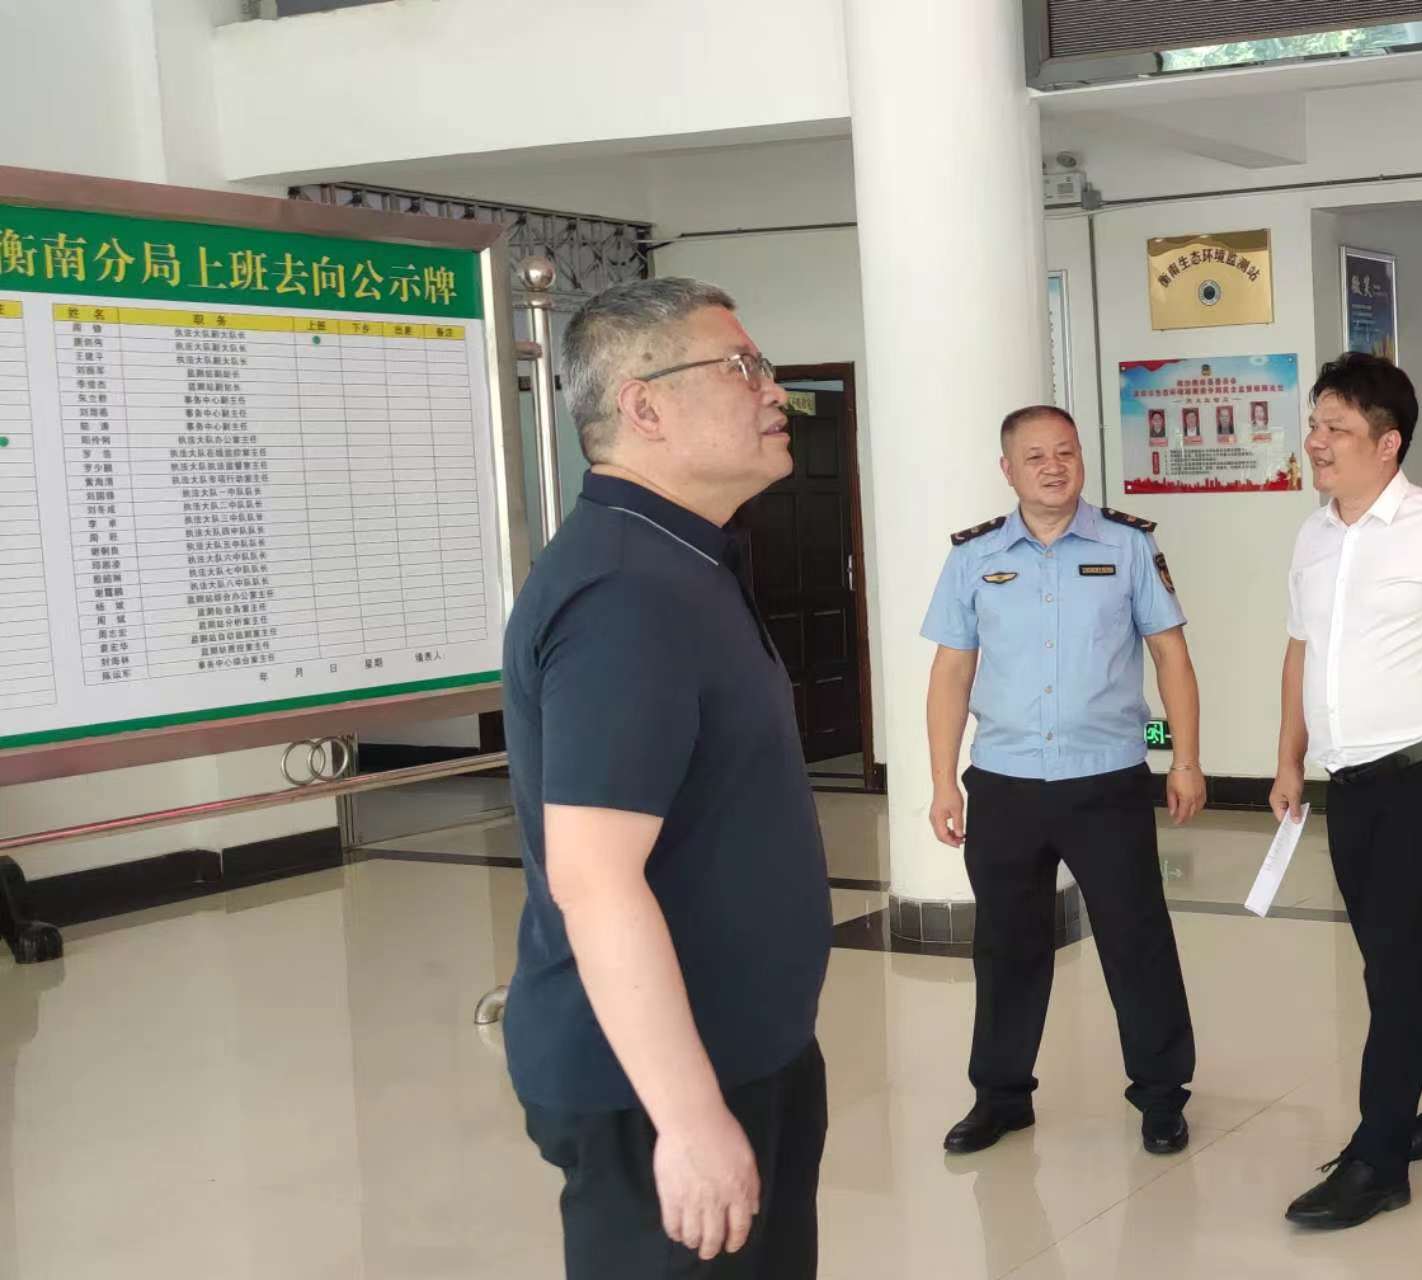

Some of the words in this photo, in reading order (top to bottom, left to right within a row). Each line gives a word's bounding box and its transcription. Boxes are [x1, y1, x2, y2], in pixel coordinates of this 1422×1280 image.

[1158, 248, 1260, 288] 衡南生态环境监测站
[192, 314, 226, 326] 职务
